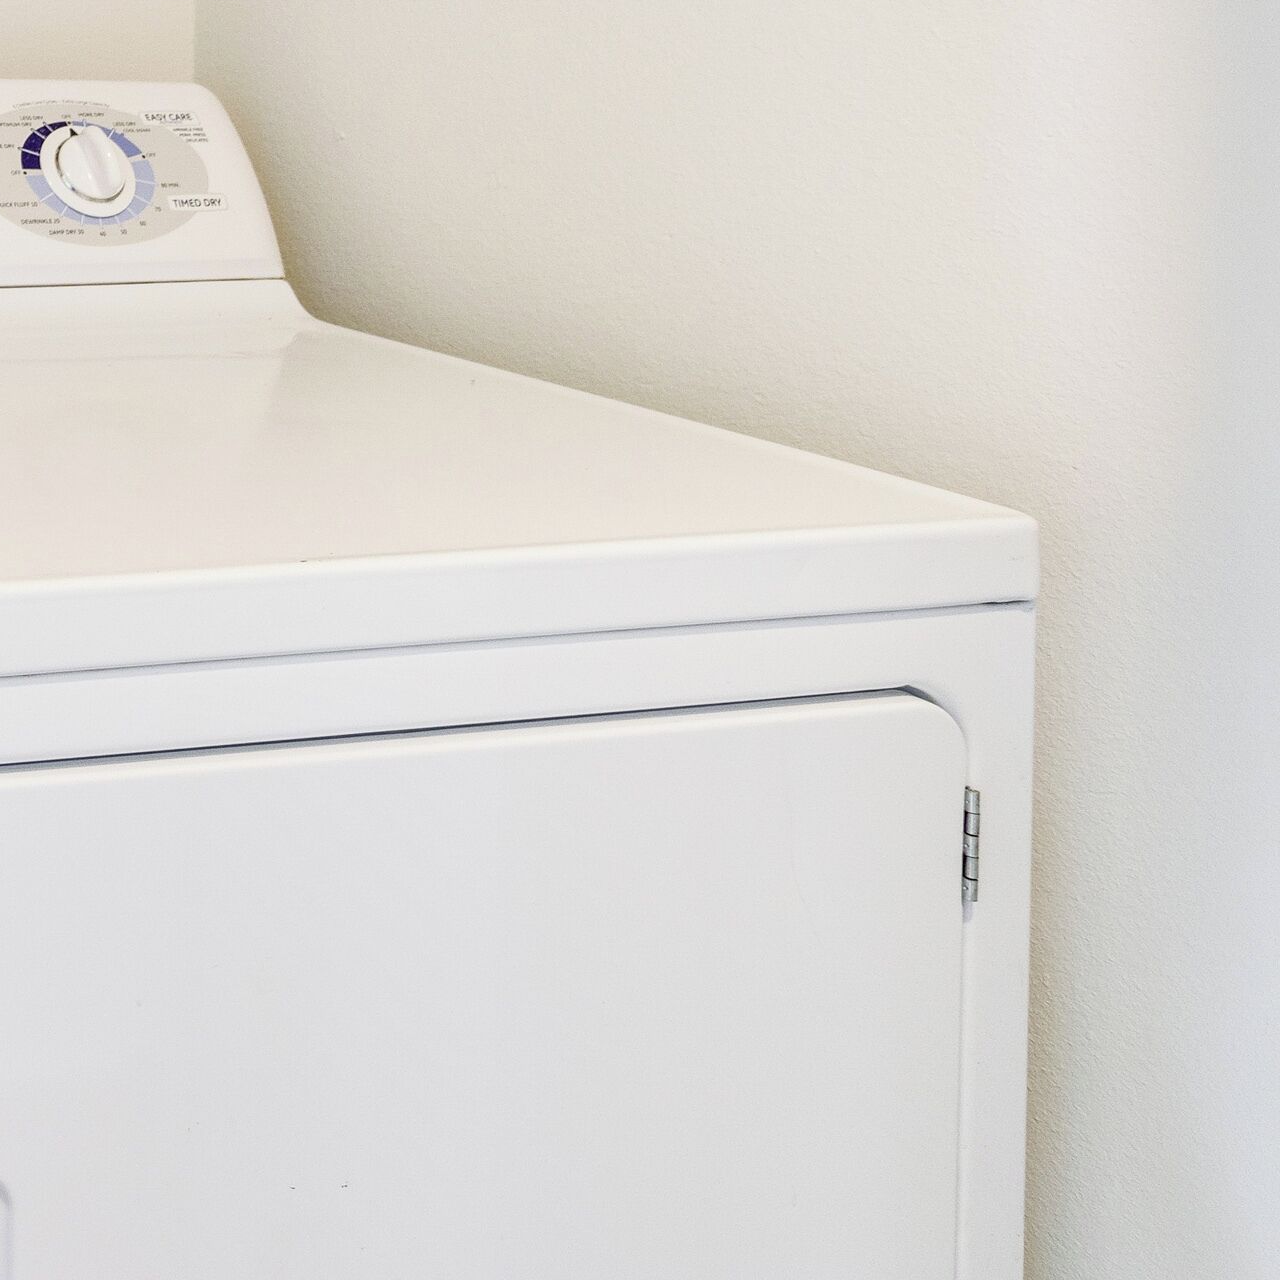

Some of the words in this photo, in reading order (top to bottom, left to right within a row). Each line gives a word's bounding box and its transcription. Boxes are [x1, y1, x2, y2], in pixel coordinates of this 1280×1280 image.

[145, 113, 167, 121] EASY
[168, 113, 193, 121] CARE
[172, 199, 201, 208] TIMED
[203, 198, 221, 207] DRY
